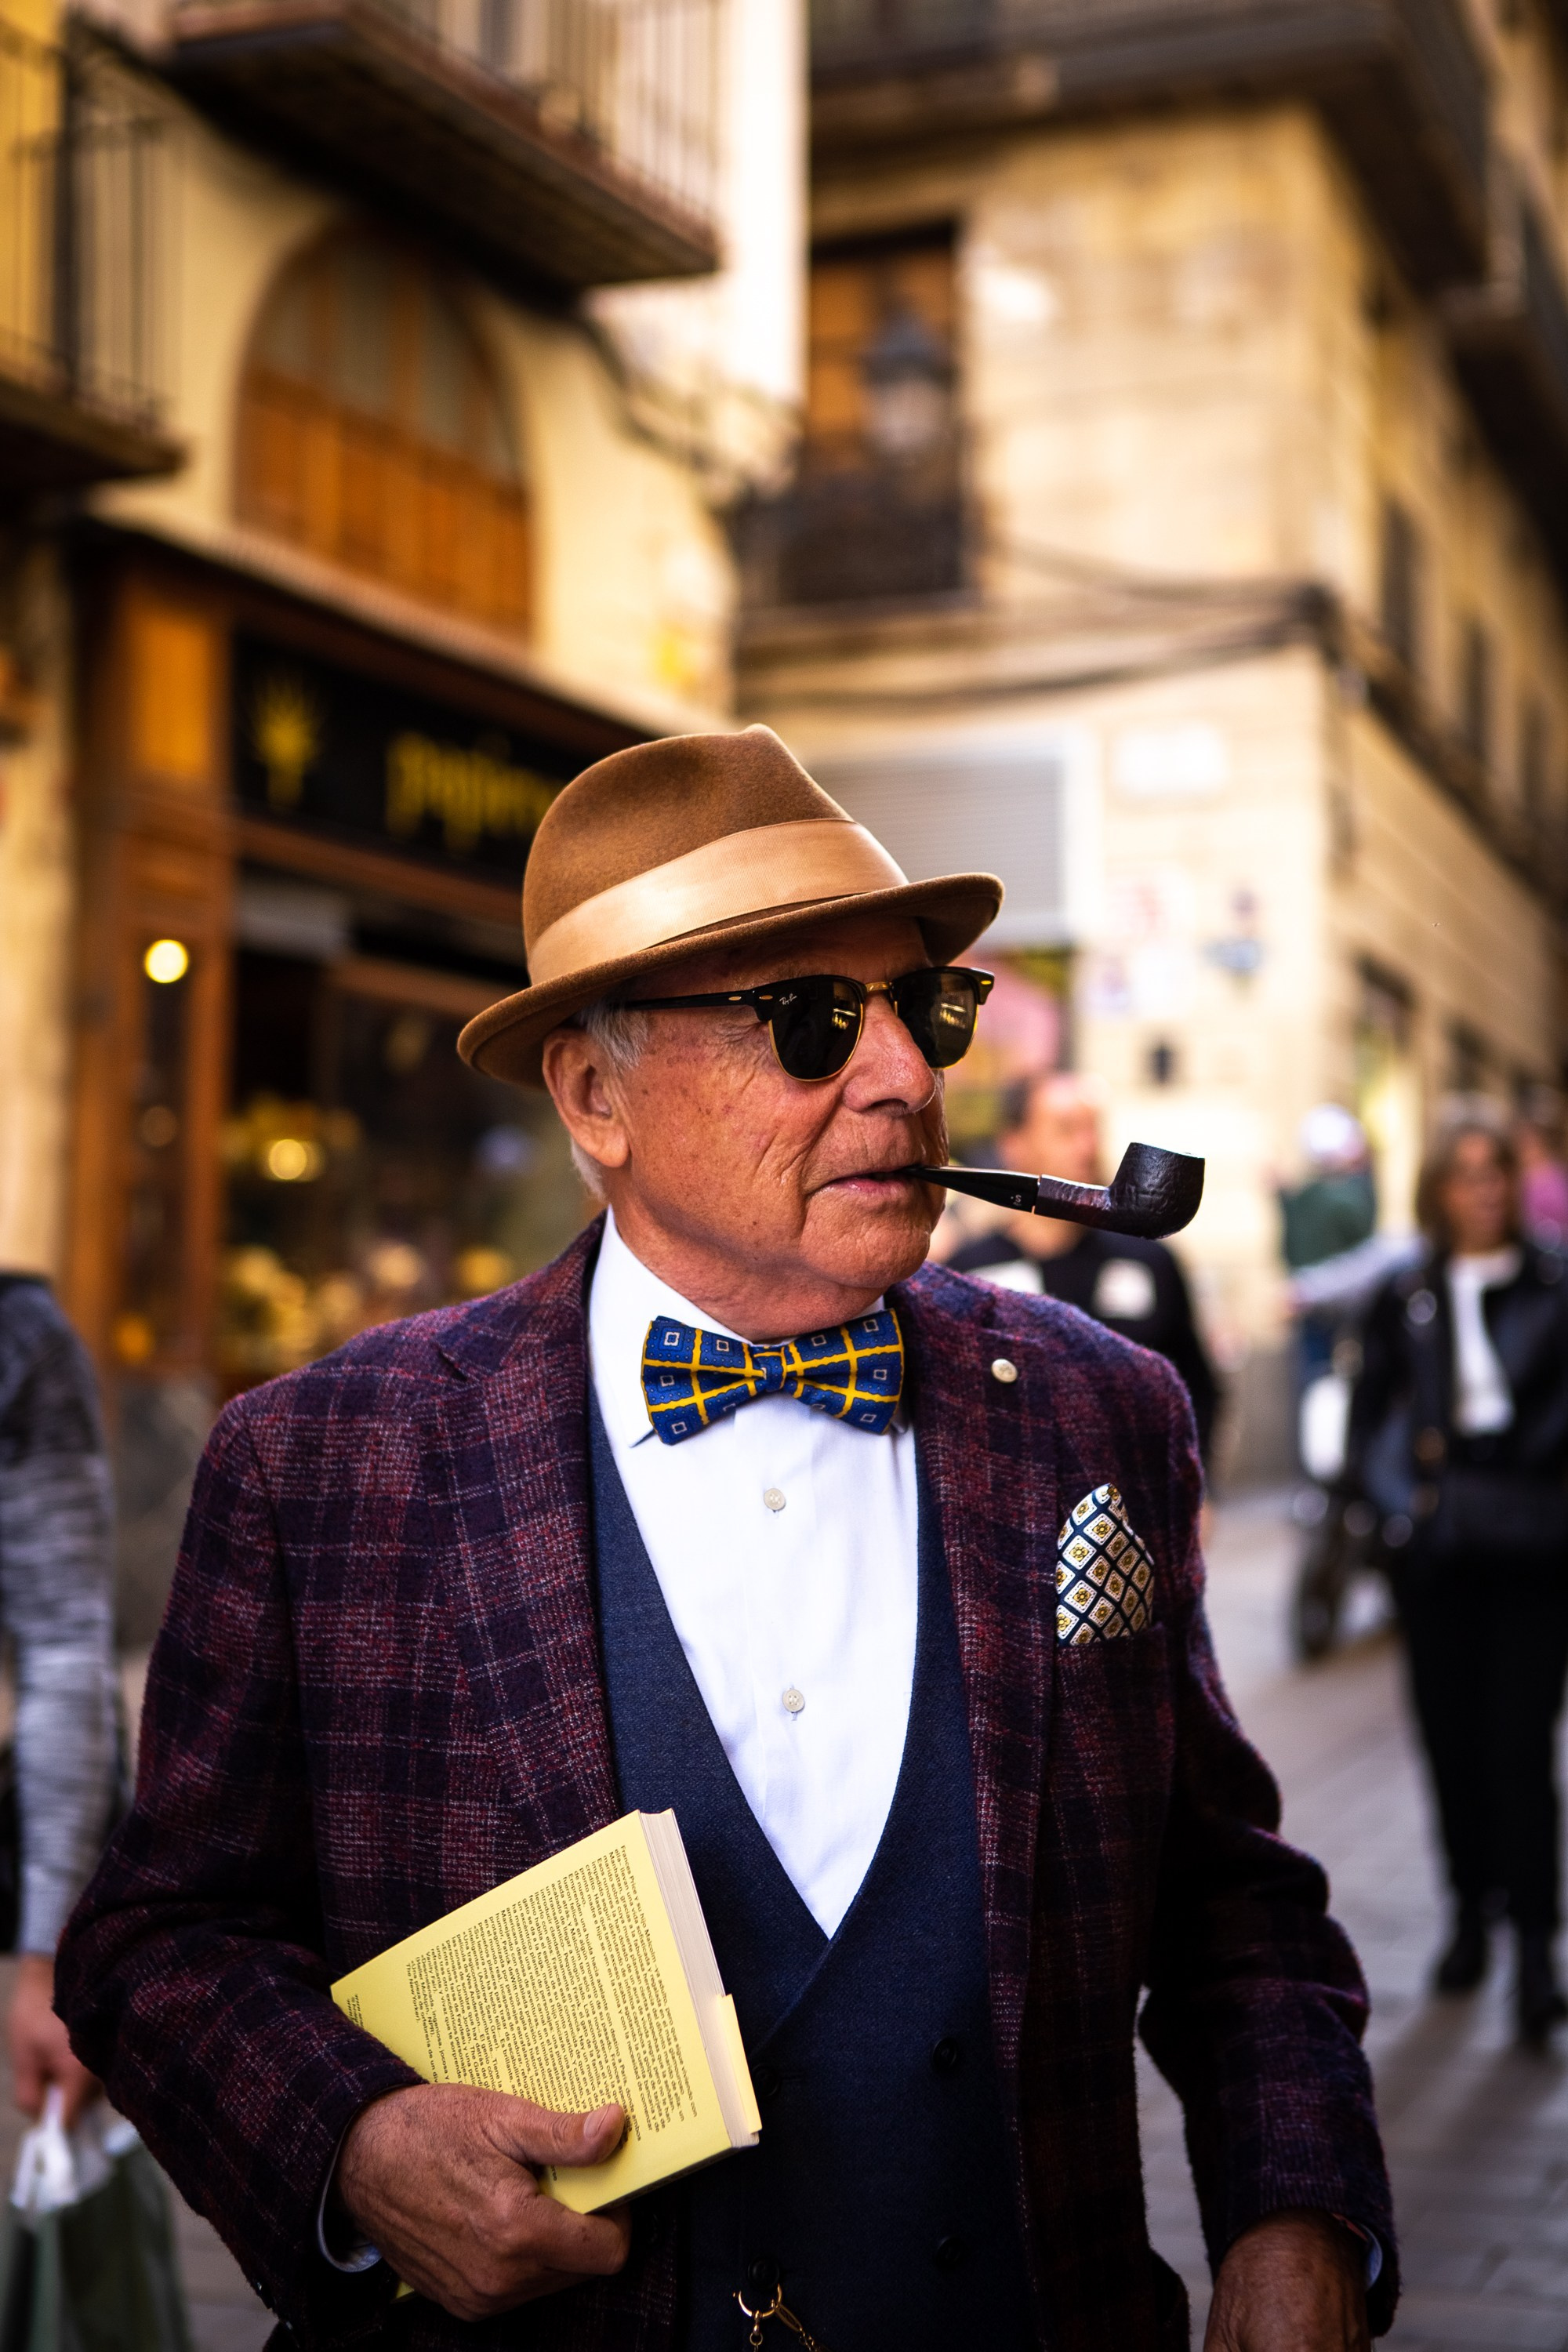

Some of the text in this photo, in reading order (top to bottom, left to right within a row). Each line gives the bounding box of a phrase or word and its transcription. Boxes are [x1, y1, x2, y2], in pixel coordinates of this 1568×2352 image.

[562, 1876, 572, 1901] fueron
[579, 1867, 590, 1893] pronto
[551, 1882, 562, 1914] acabado
[586, 1893, 597, 1918] madre
[560, 1915, 565, 1926] de
[569, 1902, 579, 1926] felices
[562, 1926, 572, 1947] llegar
[576, 1927, 582, 1938] en
[600, 1941, 605, 1951] se
[603, 1855, 613, 1882] marido
[611, 1882, 621, 1904] sobre
[622, 1925, 633, 1952] muerte
[630, 1954, 642, 1985] planean
[639, 1985, 649, 2012] ciertas
[646, 2012, 660, 2053] sospechas
[662, 2070, 666, 2078] la
[607, 1968, 613, 1978] en
[620, 1845, 631, 1875] Frances
[629, 1875, 637, 1894] Price
[636, 1902, 642, 1912] su
[644, 1929, 656, 1962] Malcolm
[664, 2007, 673, 2026] pero
[675, 2043, 684, 2065] sigue
[681, 2065, 693, 2100] viviendo
[585, 1962, 598, 1998] momento
[610, 1978, 615, 1987] la
[506, 1907, 518, 1945] americana
[516, 1947, 526, 1977] deseosa
[524, 1978, 529, 1988] de
[537, 2030, 543, 2041] un
[546, 2067, 558, 2102] detective
[539, 1888, 552, 1924] introducir
[550, 1926, 570, 1991] clandestinamente
[567, 1993, 572, 2003] en
[583, 2052, 588, 2063] un
[586, 2063, 596, 2092] motivo
[593, 2092, 599, 2103] de
[568, 1872, 583, 1917] Emprenden
[584, 1933, 593, 1955] huida
[590, 1956, 599, 1977] hacia
[596, 1978, 608, 2011] adelante
[610, 2027, 620, 2056] destino
[625, 2087, 634, 2113] donde
[632, 2114, 641, 2141] ambos
[591, 1860, 604, 1896] impedido
[601, 1897, 611, 1921] seguir
[608, 1922, 623, 1966] disfrutando
[620, 1967, 626, 1977] de
[623, 1978, 635, 2010] infinitos
[632, 2011, 645, 2049] caprichos
[643, 2056, 653, 2078] golpe
[650, 2079, 655, 2090] de
[653, 2090, 662, 2117] tarjeta
[660, 2118, 666, 2129] de
[596, 1999, 601, 2009] de
[612, 1987, 621, 2009] ruina
[502, 1940, 511, 1965] Patrick
[508, 1966, 517, 1991] deWitt
[518, 2007, 527, 2031] regala
[528, 2047, 539, 2077] historia
[534, 1916, 543, 1940] habita
[550, 1980, 556, 1990] de
[553, 1991, 559, 2001] su
[556, 2002, 566, 2029] difunto
[581, 2099, 587, 2109] ya
[598, 2011, 604, 2021] su
[619, 1895, 631, 1923] gracias
[630, 1929, 636, 1938] la
[633, 1938, 645, 1972] fabulosa
[642, 1972, 655, 2006] herencia
[655, 2021, 666, 2049] difunto
[663, 2050, 673, 2079] marido
[670, 2080, 677, 2091] de
[678, 2110, 684, 2122] un
[486, 1959, 497, 1990] placeres
[499, 2009, 507, 2029] tratar
[504, 2031, 510, 2042] de
[507, 2042, 521, 2087] escabullirse
[624, 2031, 630, 2039] la
[598, 2060, 604, 2071] en
[610, 2053, 620, 2084] Frances
[626, 2040, 641, 2080] necesidad
[604, 2080, 613, 2099] viaje
[618, 2085, 628, 2114] apenas
[637, 2081, 643, 2092] de
[640, 2092, 652, 2130] comenzar
